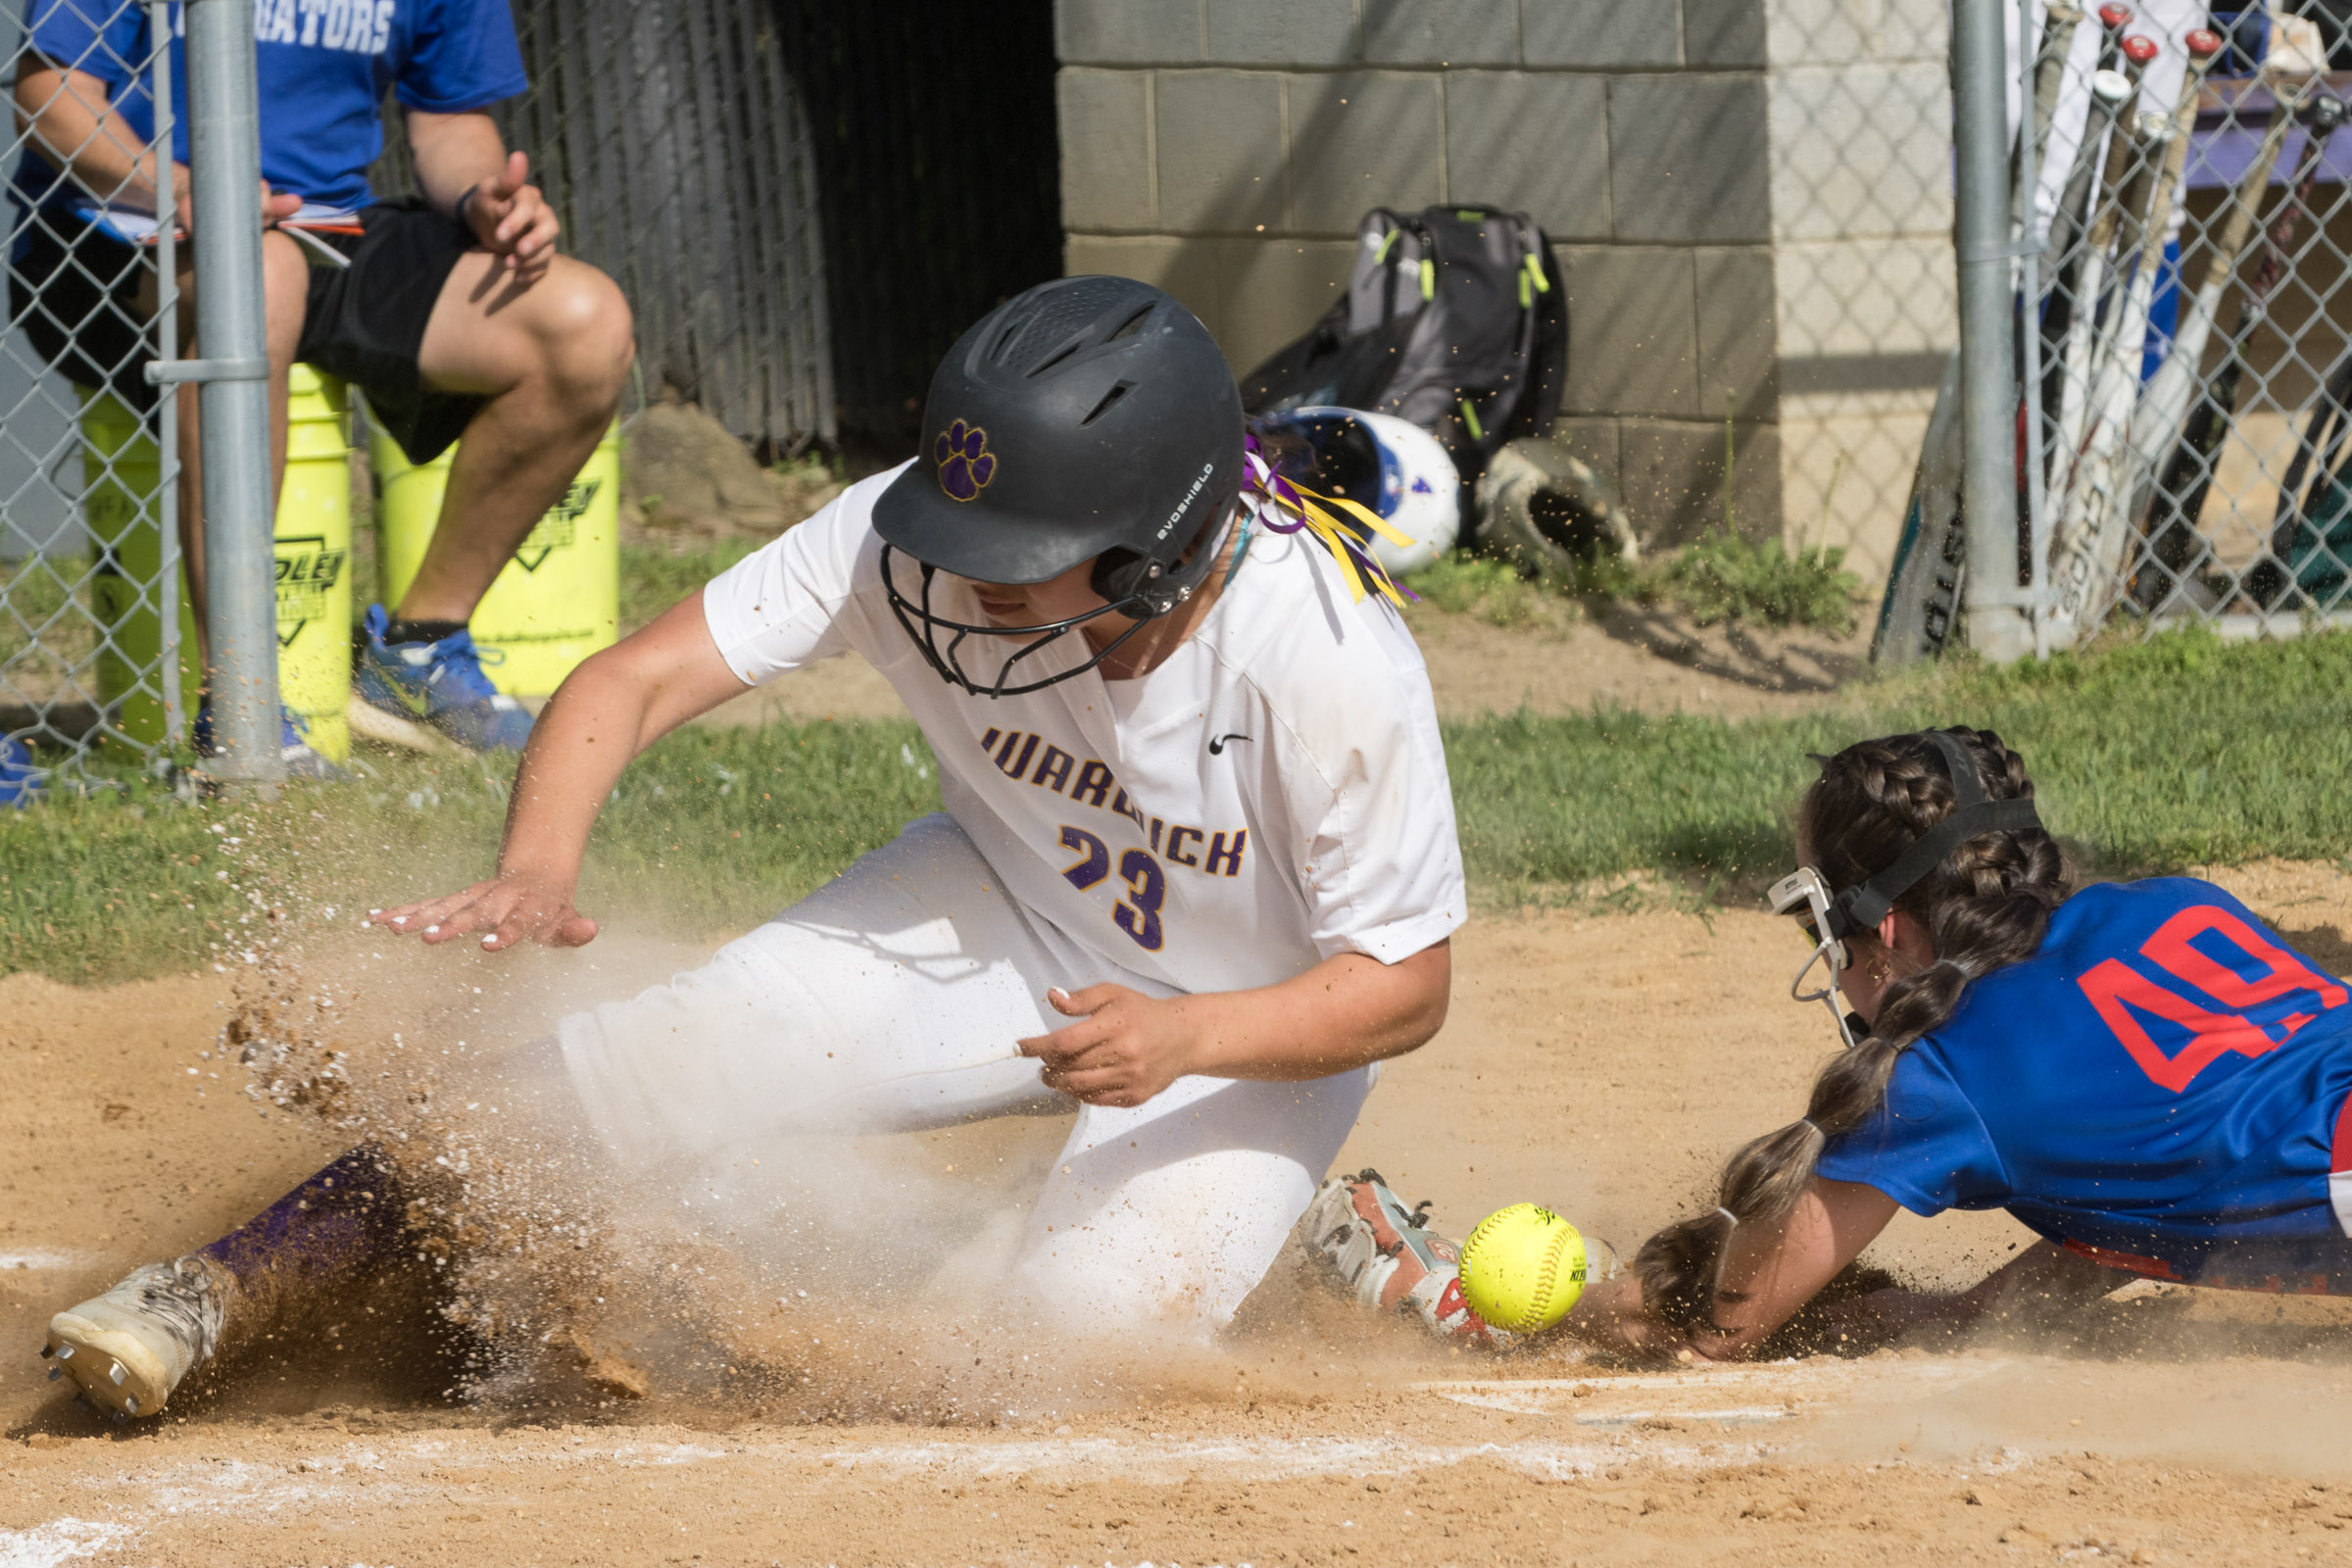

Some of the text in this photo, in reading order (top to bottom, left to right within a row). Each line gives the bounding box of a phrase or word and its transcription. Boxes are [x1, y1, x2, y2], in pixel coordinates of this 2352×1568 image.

[1156, 463, 1214, 540] EVOSHIELD
[1057, 823, 1166, 953] 23
[2076, 904, 2349, 1095] 49
